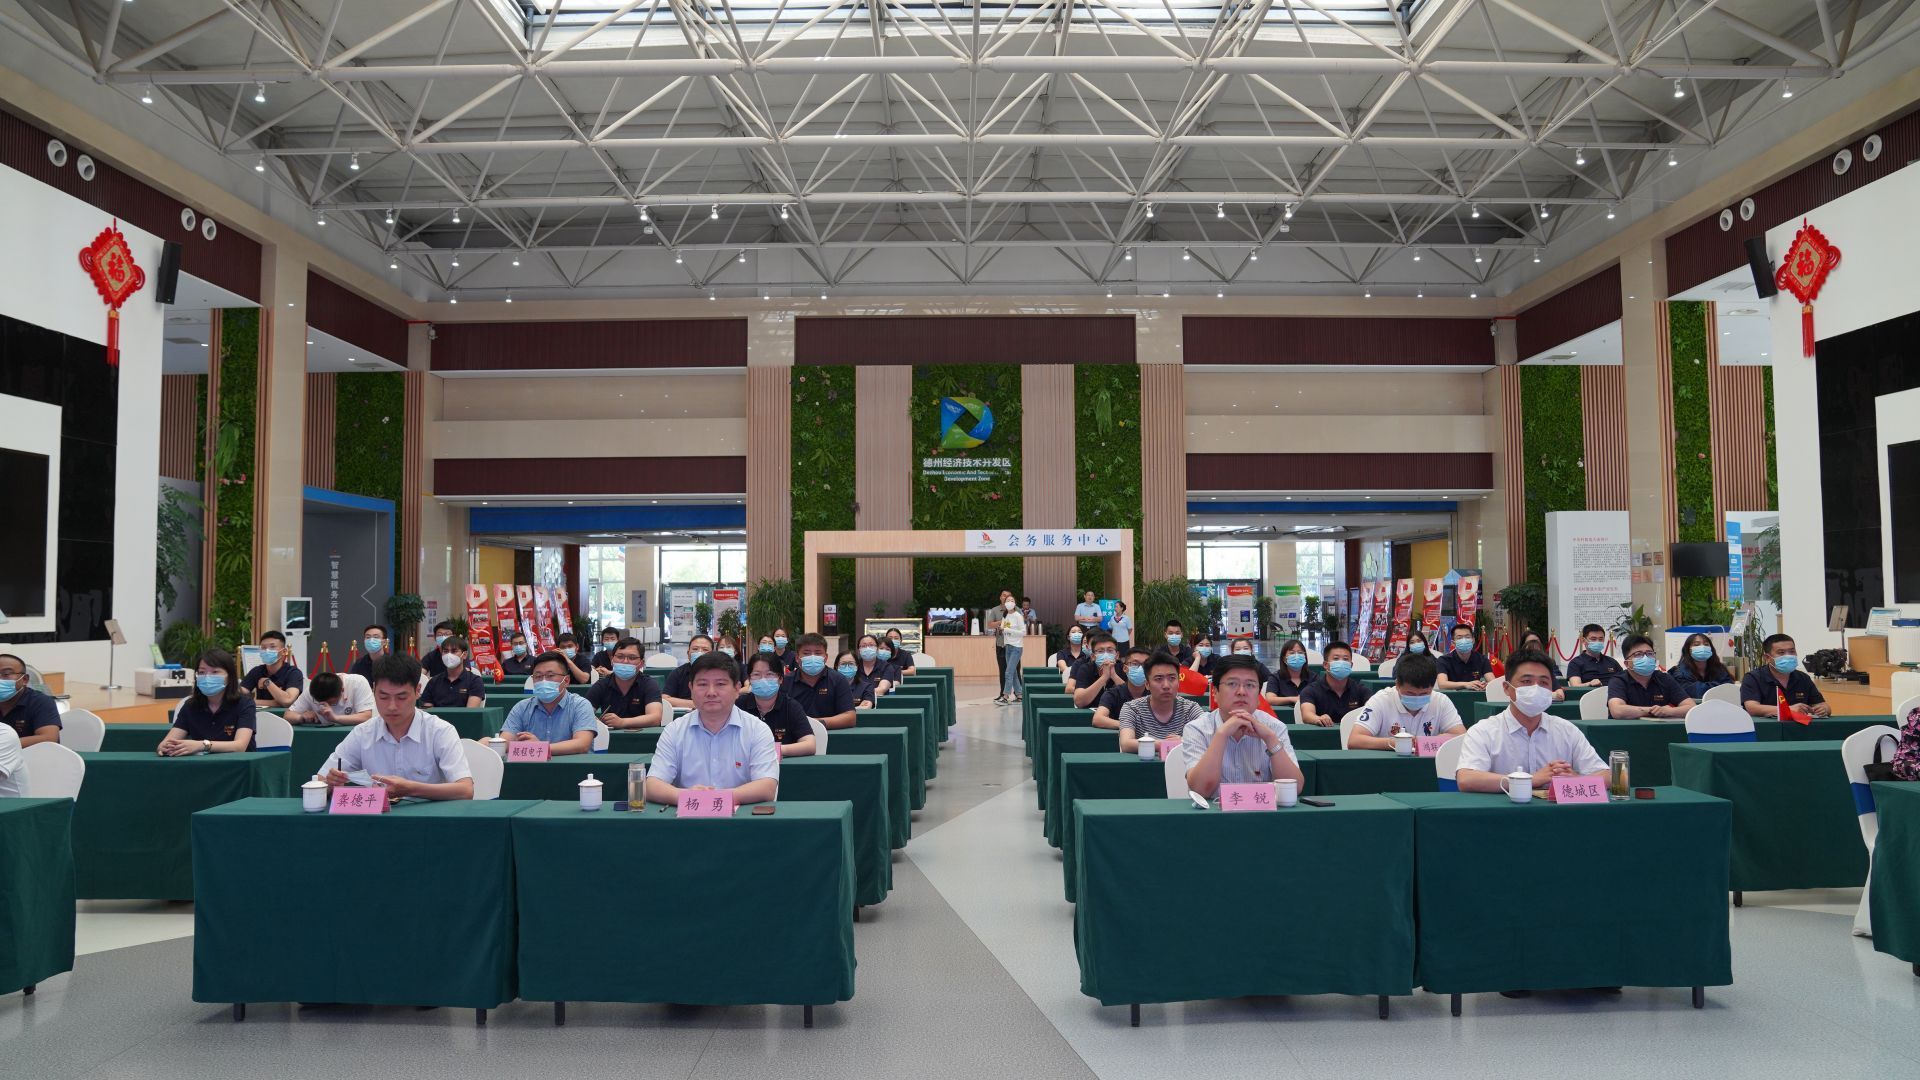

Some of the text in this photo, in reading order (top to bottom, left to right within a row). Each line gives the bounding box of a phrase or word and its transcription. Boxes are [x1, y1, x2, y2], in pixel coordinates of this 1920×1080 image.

[108, 251, 125, 282] 福
[1796, 248, 1815, 276] 福
[922, 457, 1012, 468] 德州经济技术开发区
[1008, 533, 1109, 547] 会务服务中心
[1360, 708, 1373, 721] 5
[1561, 784, 1600, 798] 德城区
[684, 797, 723, 812] 杨勇
[1229, 791, 1270, 806] 李锐
